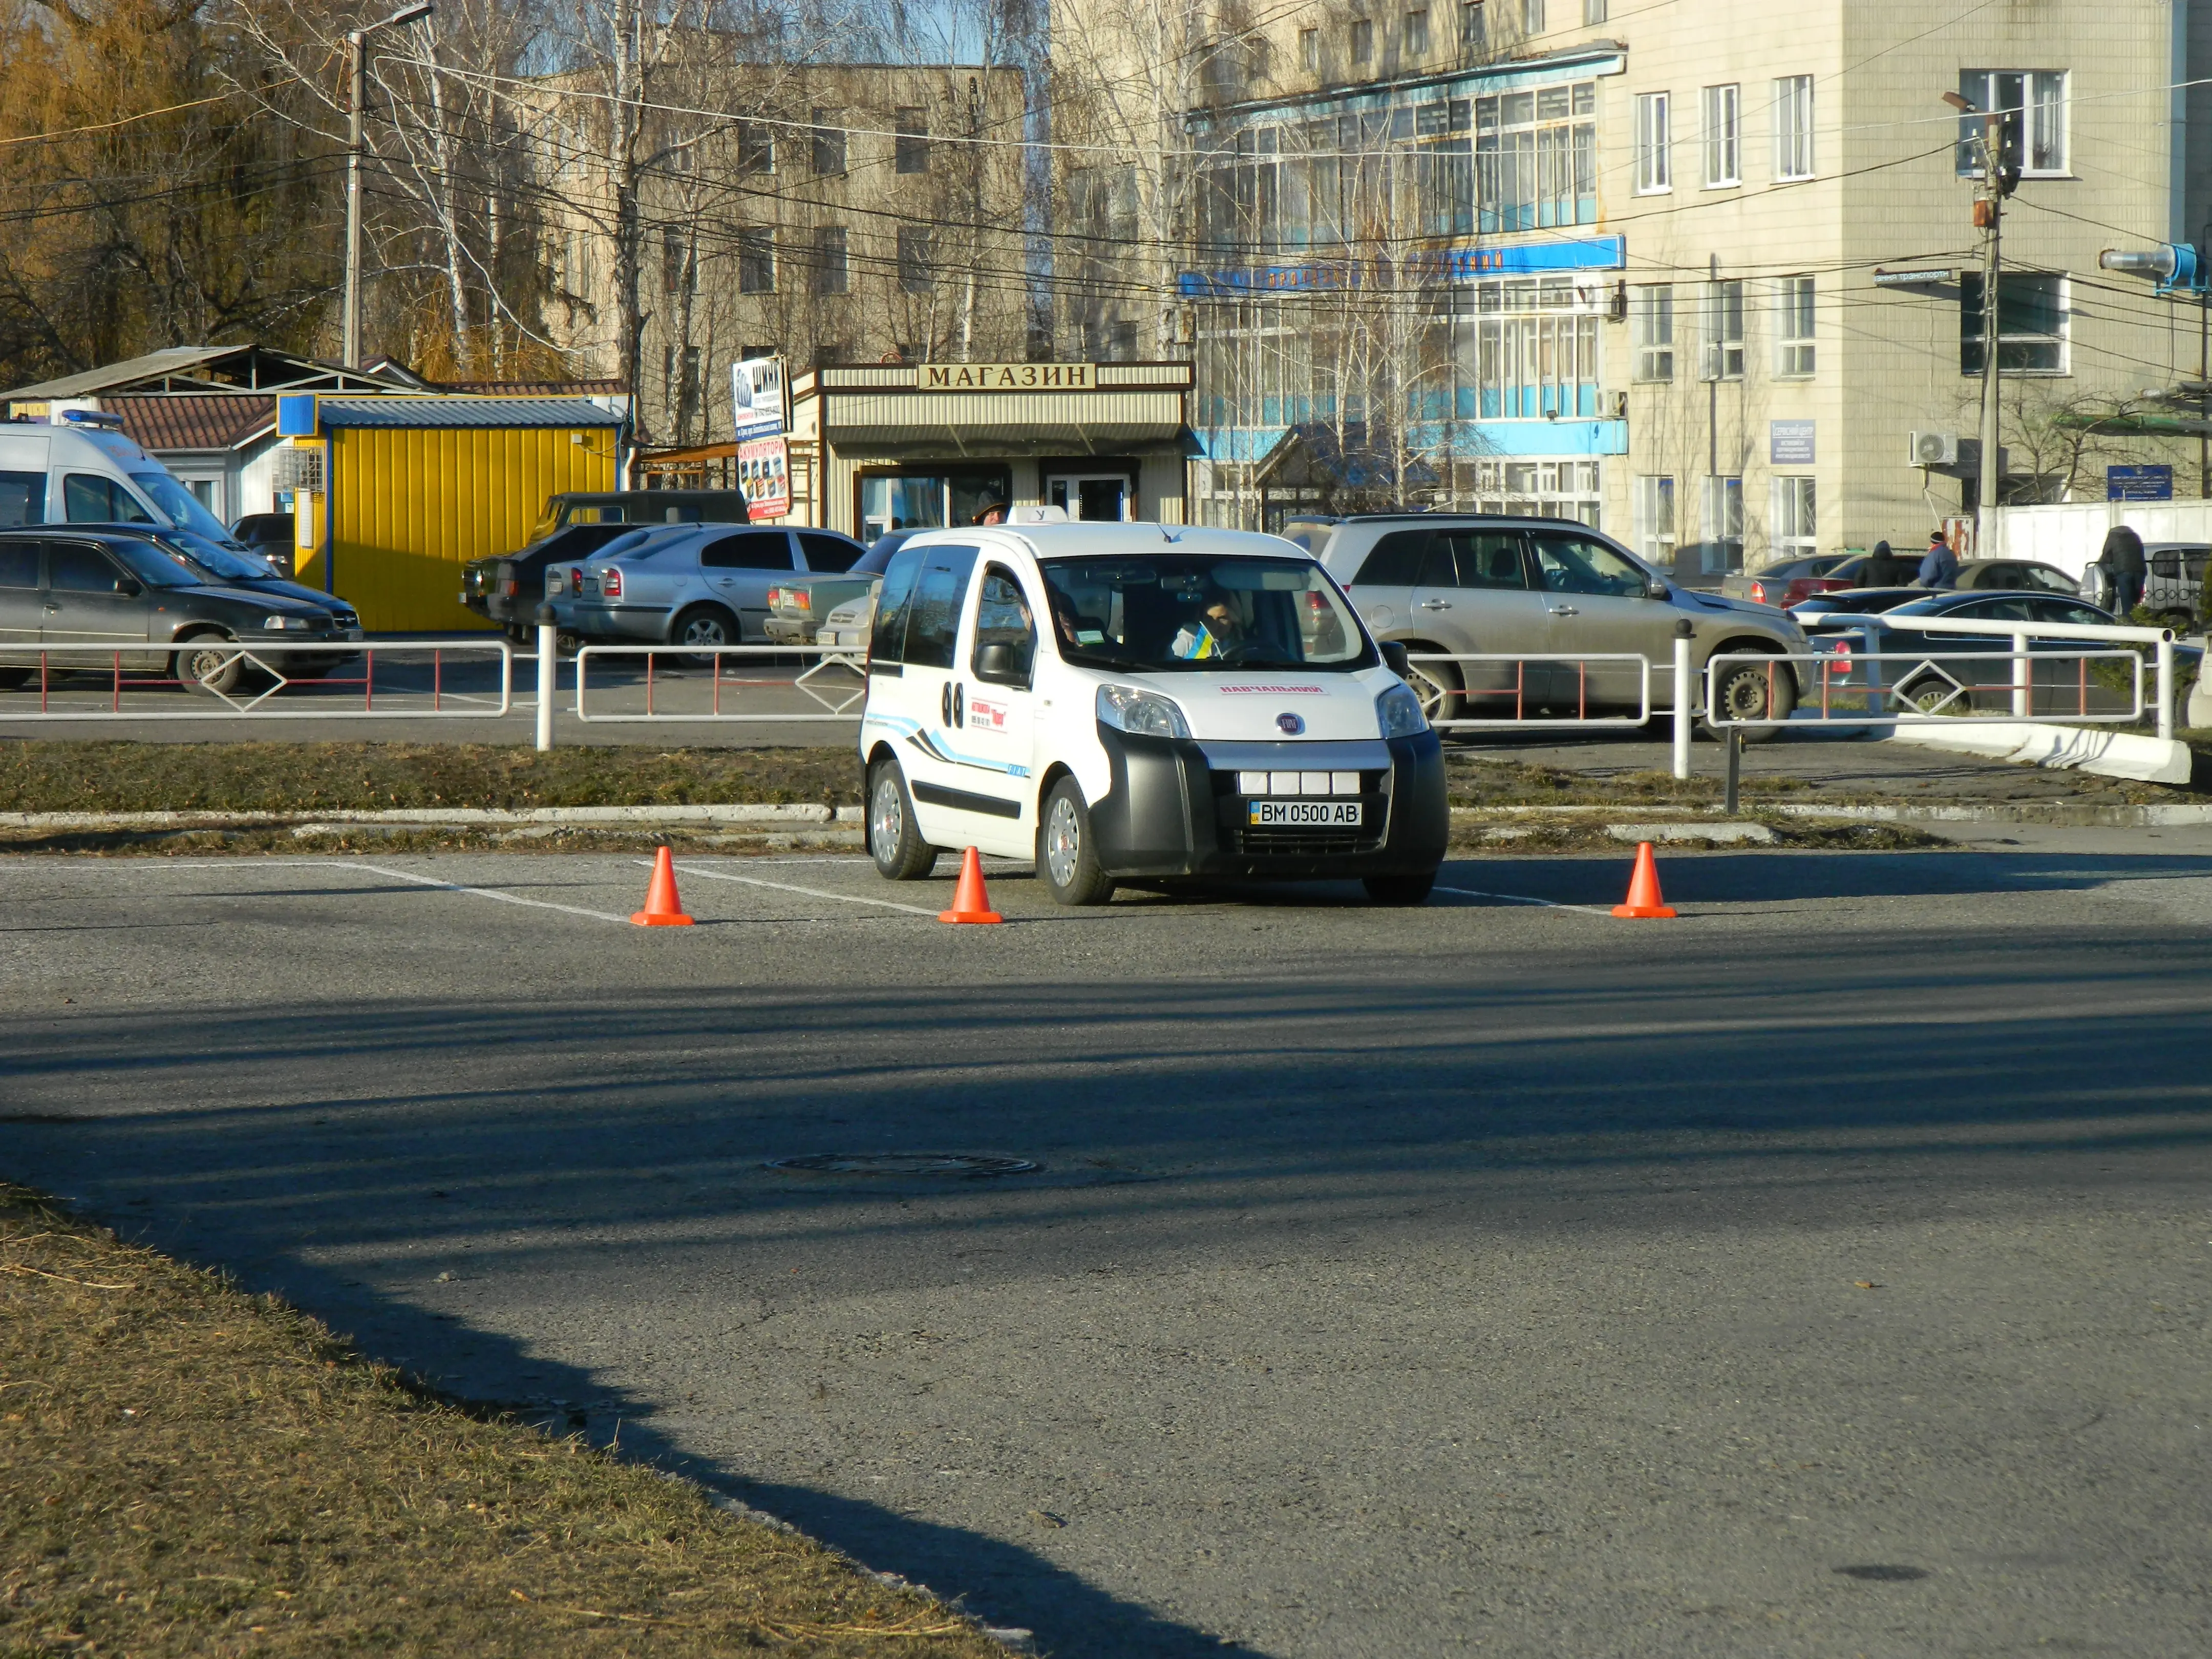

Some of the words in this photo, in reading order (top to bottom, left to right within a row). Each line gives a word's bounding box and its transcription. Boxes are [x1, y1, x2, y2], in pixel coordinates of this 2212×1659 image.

[753, 364, 779, 393] ШИНИ
[928, 367, 1086, 387] МАГАЗИН
[739, 440, 783, 459] АКУМУЛЯТОРИ
[1282, 718, 1297, 729] FIAT
[1008, 765, 1026, 777] FIAT
[1261, 804, 1286, 822] BM
[1291, 805, 1329, 822] 0500
[1334, 805, 1357, 822] AB
